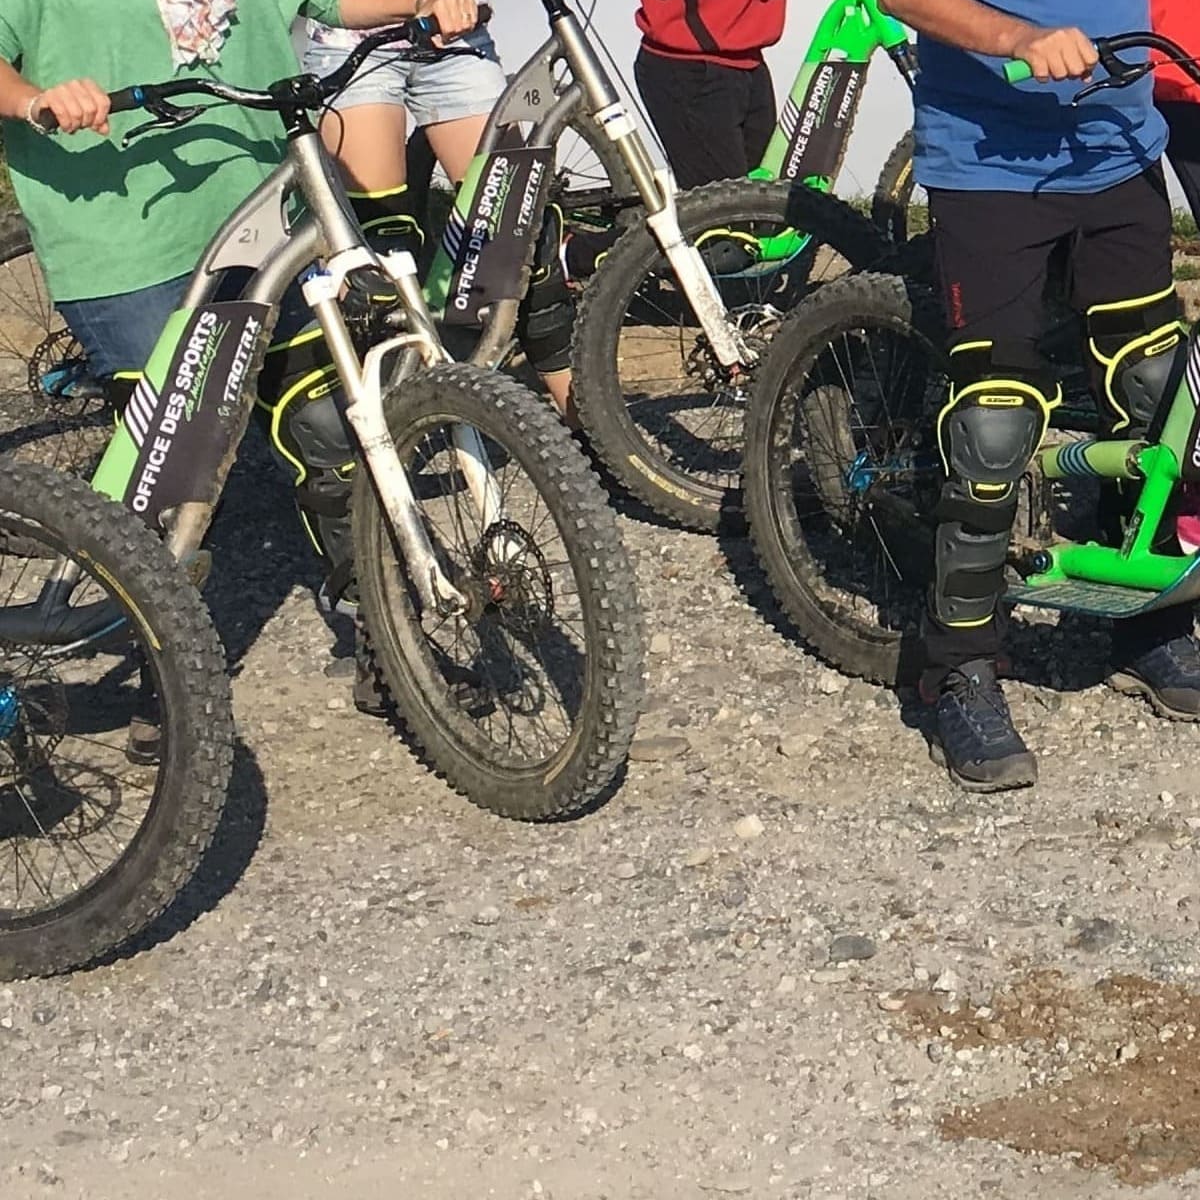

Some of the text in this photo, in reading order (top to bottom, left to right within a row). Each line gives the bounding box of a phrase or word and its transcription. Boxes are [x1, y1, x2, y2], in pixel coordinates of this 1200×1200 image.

[523, 89, 541, 106] 18
[786, 65, 834, 178] OFFICE DES SPORTS
[238, 227, 260, 244] 21
[454, 156, 509, 310] OFFICE DES SPORTS
[518, 158, 544, 225] TROTRX
[223, 314, 260, 402] TROTRX
[132, 311, 218, 513] OFFICE DES SPORTS
